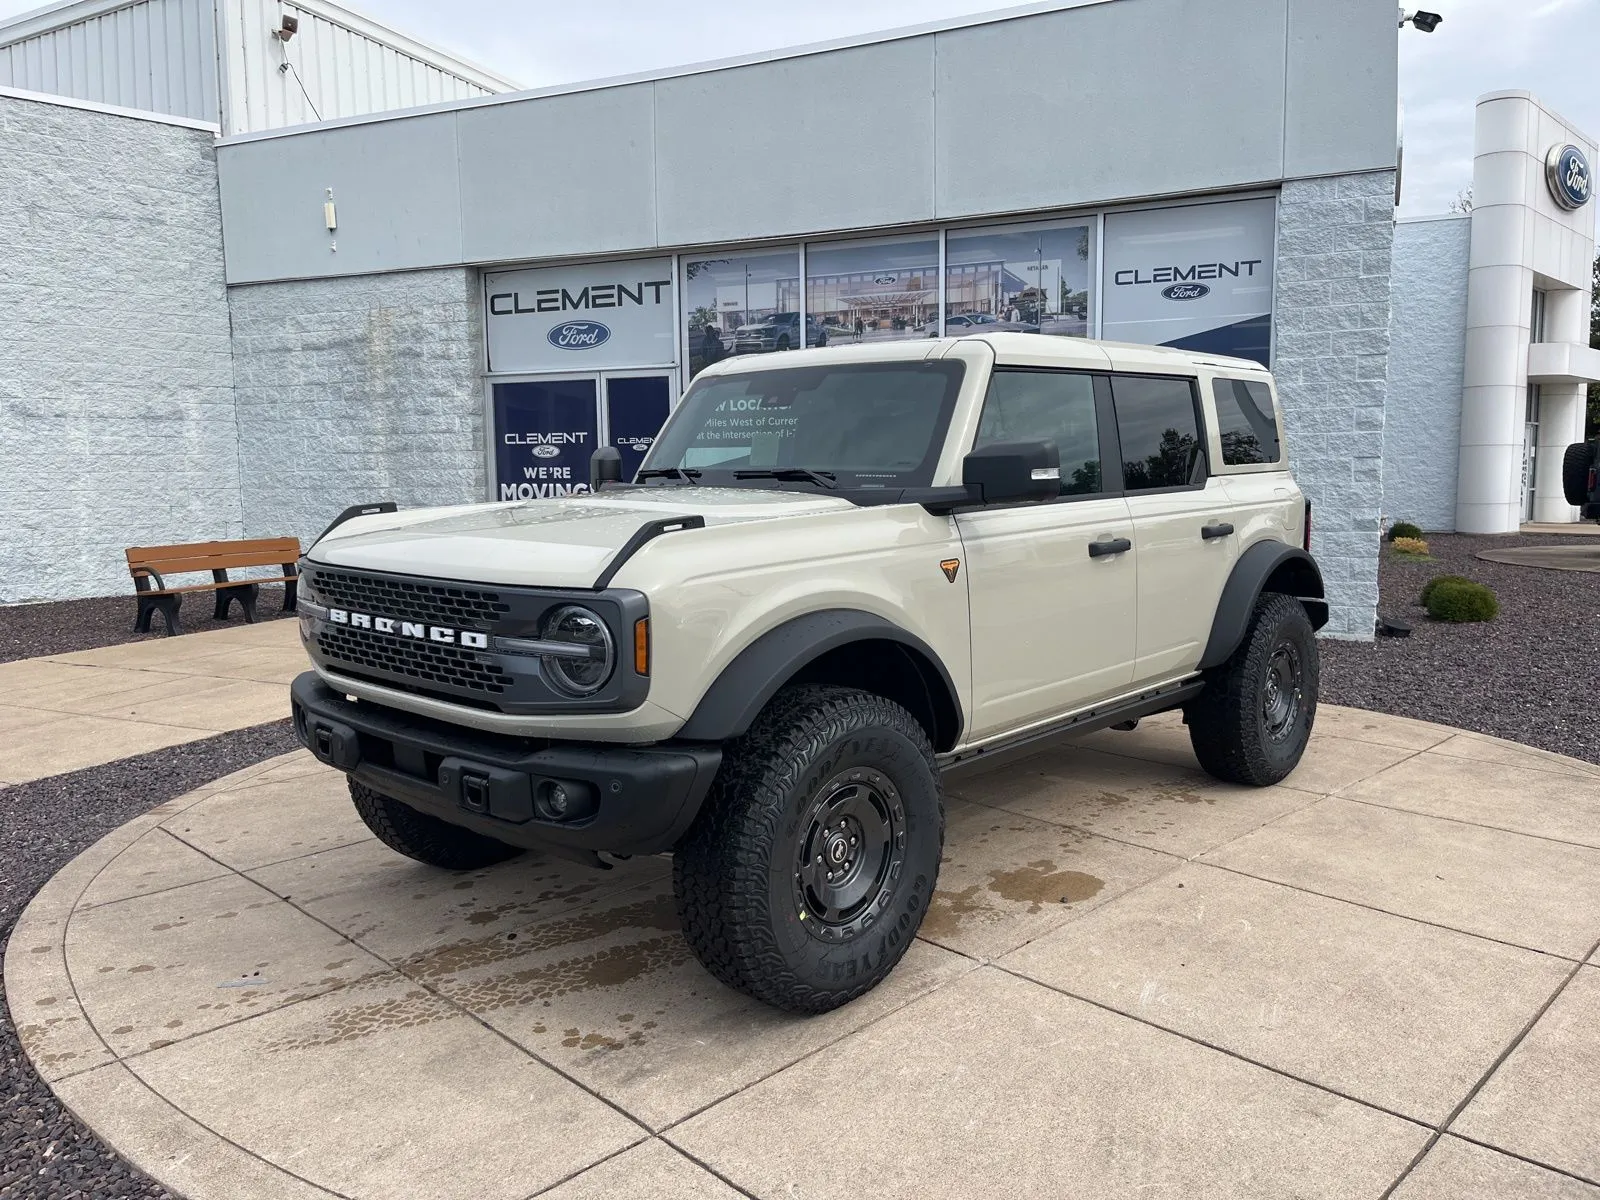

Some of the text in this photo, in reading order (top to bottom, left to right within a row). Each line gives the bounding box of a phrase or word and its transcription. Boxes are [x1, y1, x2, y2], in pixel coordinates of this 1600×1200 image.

[1566, 156, 1588, 195] Ford
[1115, 260, 1262, 286] CLEMENT
[490, 281, 671, 316] CLEMENT
[1170, 285, 1200, 299] Ford
[558, 324, 599, 346] Ford
[729, 418, 753, 427] West
[755, 417, 766, 426] of
[504, 432, 588, 444] CLEMENT
[706, 430, 721, 440] the
[537, 447, 555, 456] Ford
[523, 466, 571, 479] WE'RE
[329, 608, 488, 649] BRONCO
